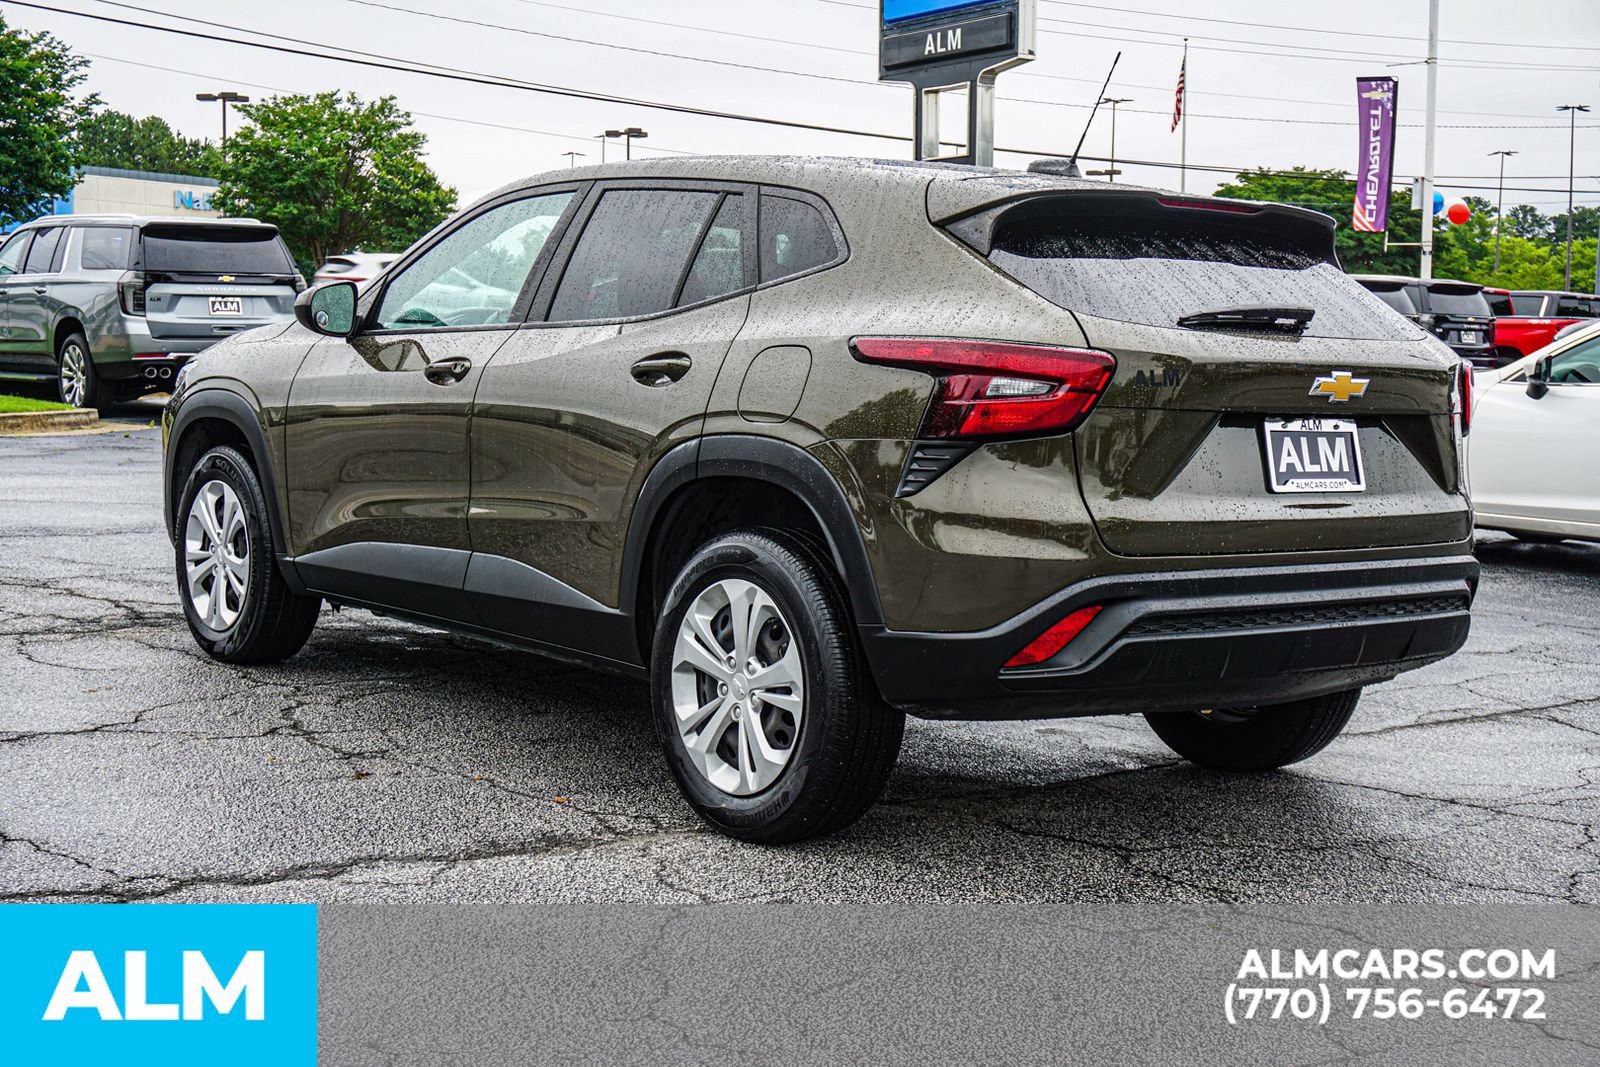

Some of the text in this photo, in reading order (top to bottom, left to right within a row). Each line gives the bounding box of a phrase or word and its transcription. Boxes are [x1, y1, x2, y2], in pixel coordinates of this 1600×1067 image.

[924, 28, 962, 56] ALM
[213, 301, 238, 311] ALM
[1135, 367, 1180, 387] ALM
[1300, 418, 1322, 431] ALM
[1278, 436, 1350, 472] ALM
[1296, 481, 1345, 490] ALMCARS.COM
